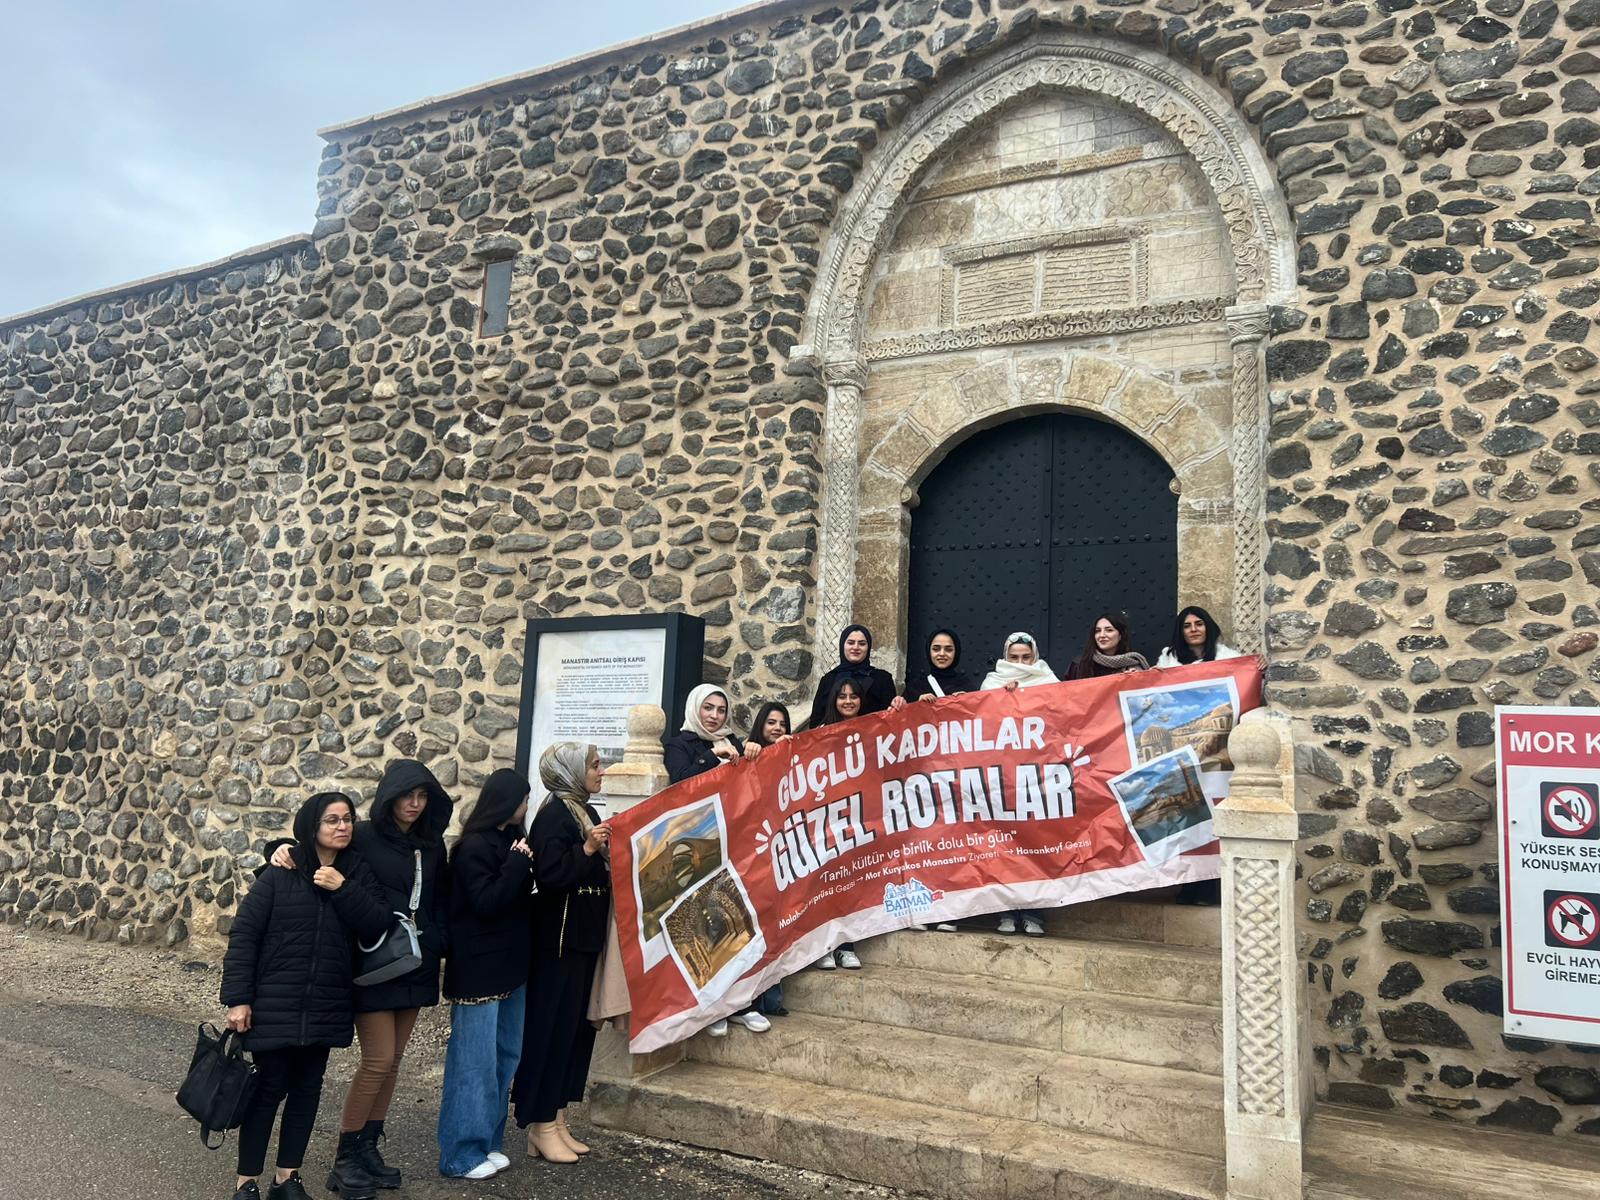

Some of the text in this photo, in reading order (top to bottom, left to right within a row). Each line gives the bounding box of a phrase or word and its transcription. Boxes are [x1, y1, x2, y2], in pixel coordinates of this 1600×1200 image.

[1509, 730, 1577, 754] MOR
[777, 716, 1046, 812] GÜÇLÜ KADINLAR
[770, 763, 1076, 892] GÜZEL ROTALAR
[852, 852, 884, 872] kültür
[887, 849, 900, 859] ve
[903, 842, 934, 856] birlik
[937, 837, 964, 851] dolu
[966, 833, 985, 846] bir
[865, 871, 881, 881] Mor
[968, 850, 1000, 863] Ziyareti
[1016, 842, 1063, 856] Hasankeyf
[1064, 838, 1092, 850] Gezisi
[1520, 841, 1600, 858] YÜKSEK SE
[885, 892, 933, 912] BATMAN
[1526, 951, 1566, 966] EVCİL
